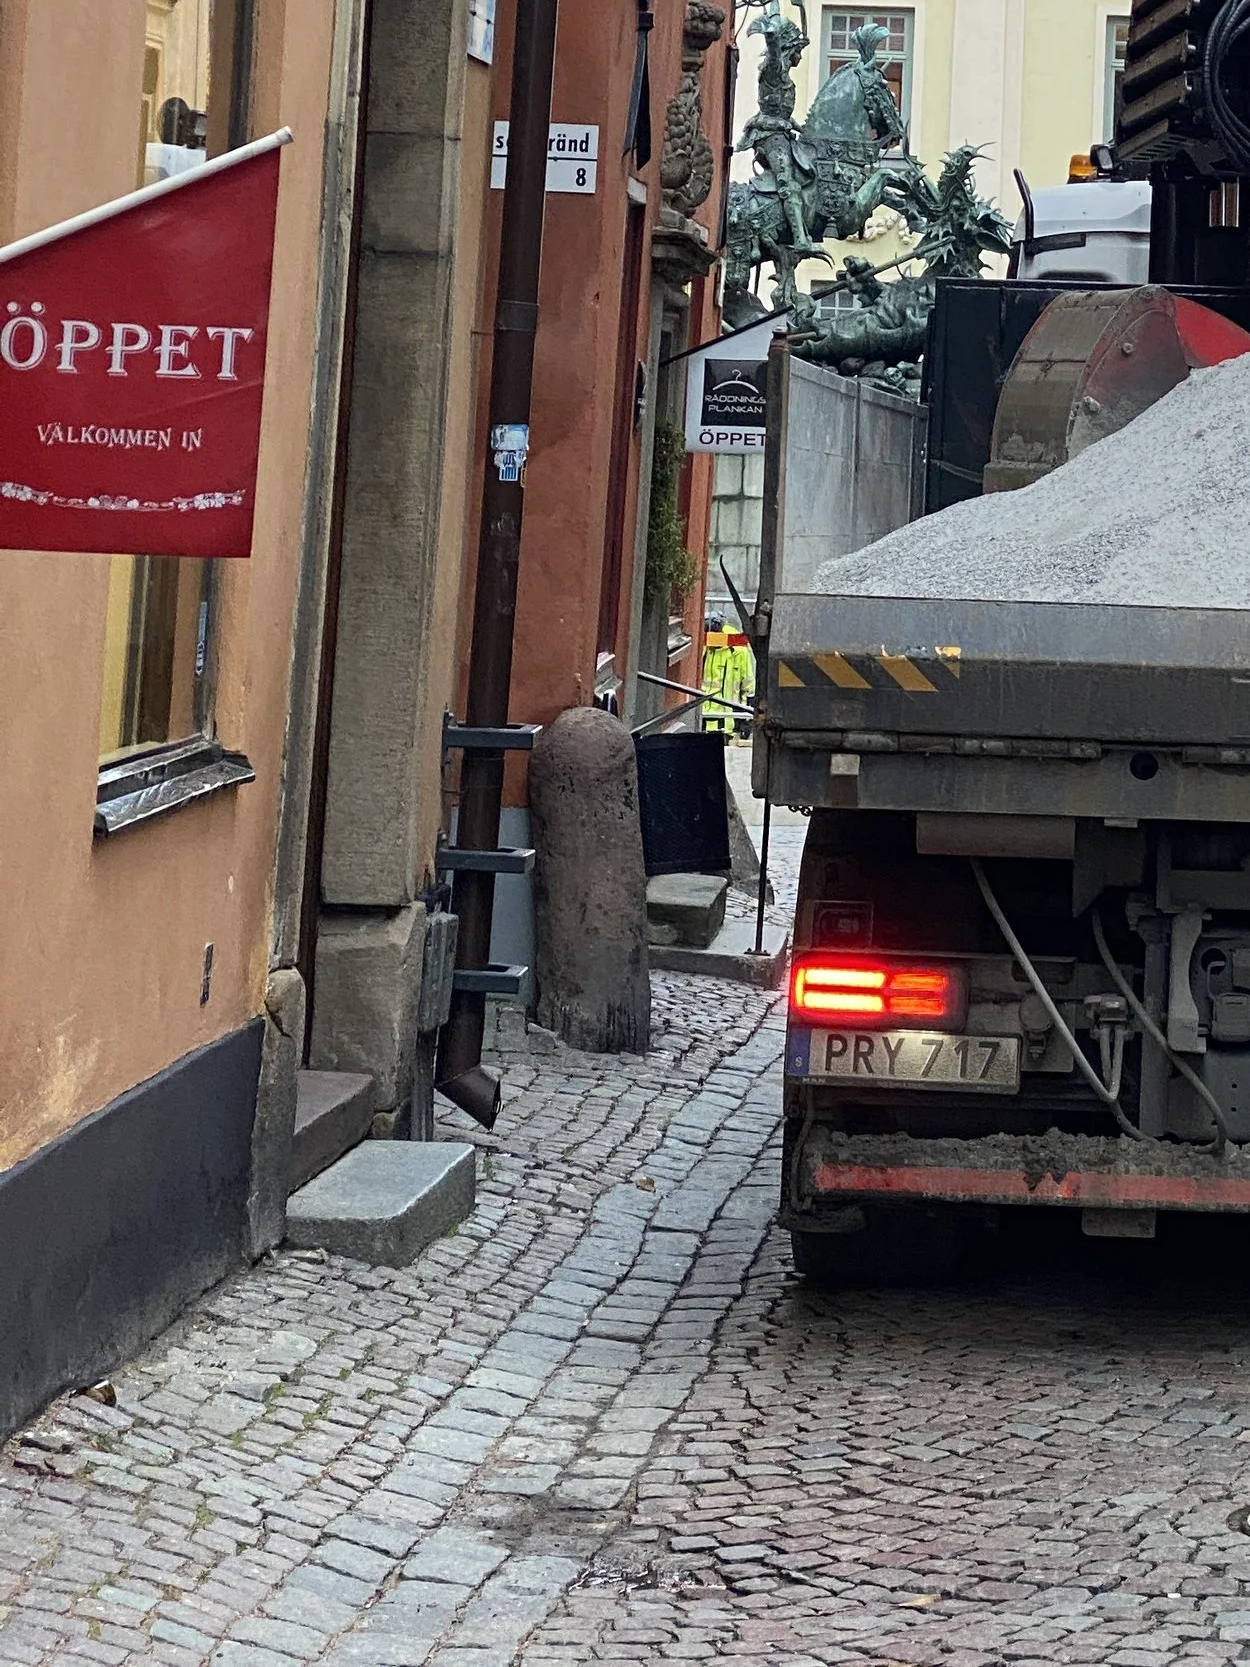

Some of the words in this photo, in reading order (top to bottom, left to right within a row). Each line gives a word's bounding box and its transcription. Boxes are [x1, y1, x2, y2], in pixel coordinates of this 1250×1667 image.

[575, 167, 587, 187] 8
[0, 300, 255, 382] ÖPPET
[707, 404, 763, 414] PLANKAN
[37, 422, 172, 451] VÄLKOMMEN
[182, 427, 203, 453] IN
[699, 428, 767, 447] ÖPPET
[824, 1033, 906, 1075] PRY
[920, 1038, 1001, 1080] 717
